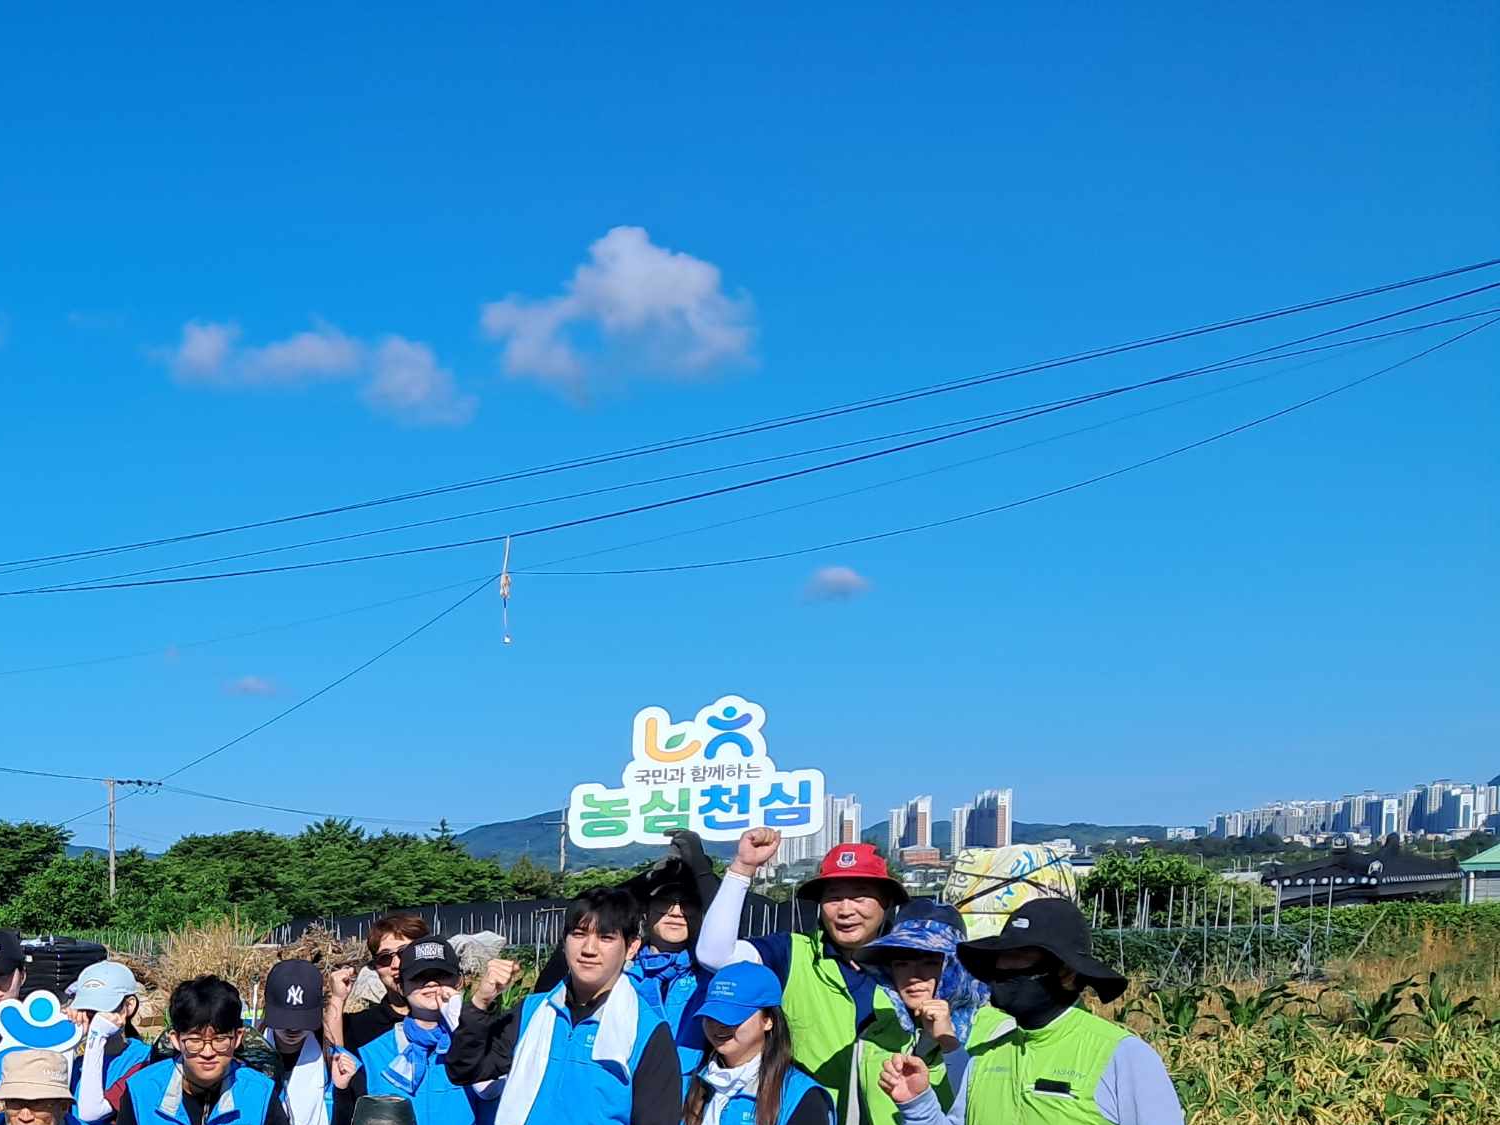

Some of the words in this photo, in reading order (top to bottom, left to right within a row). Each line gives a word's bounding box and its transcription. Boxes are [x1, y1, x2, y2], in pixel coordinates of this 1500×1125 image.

[634, 767, 686, 785] 국민과
[691, 763, 762, 782] 함께하는
[579, 780, 811, 838] 농심천심
[286, 984, 304, 1006] NY
